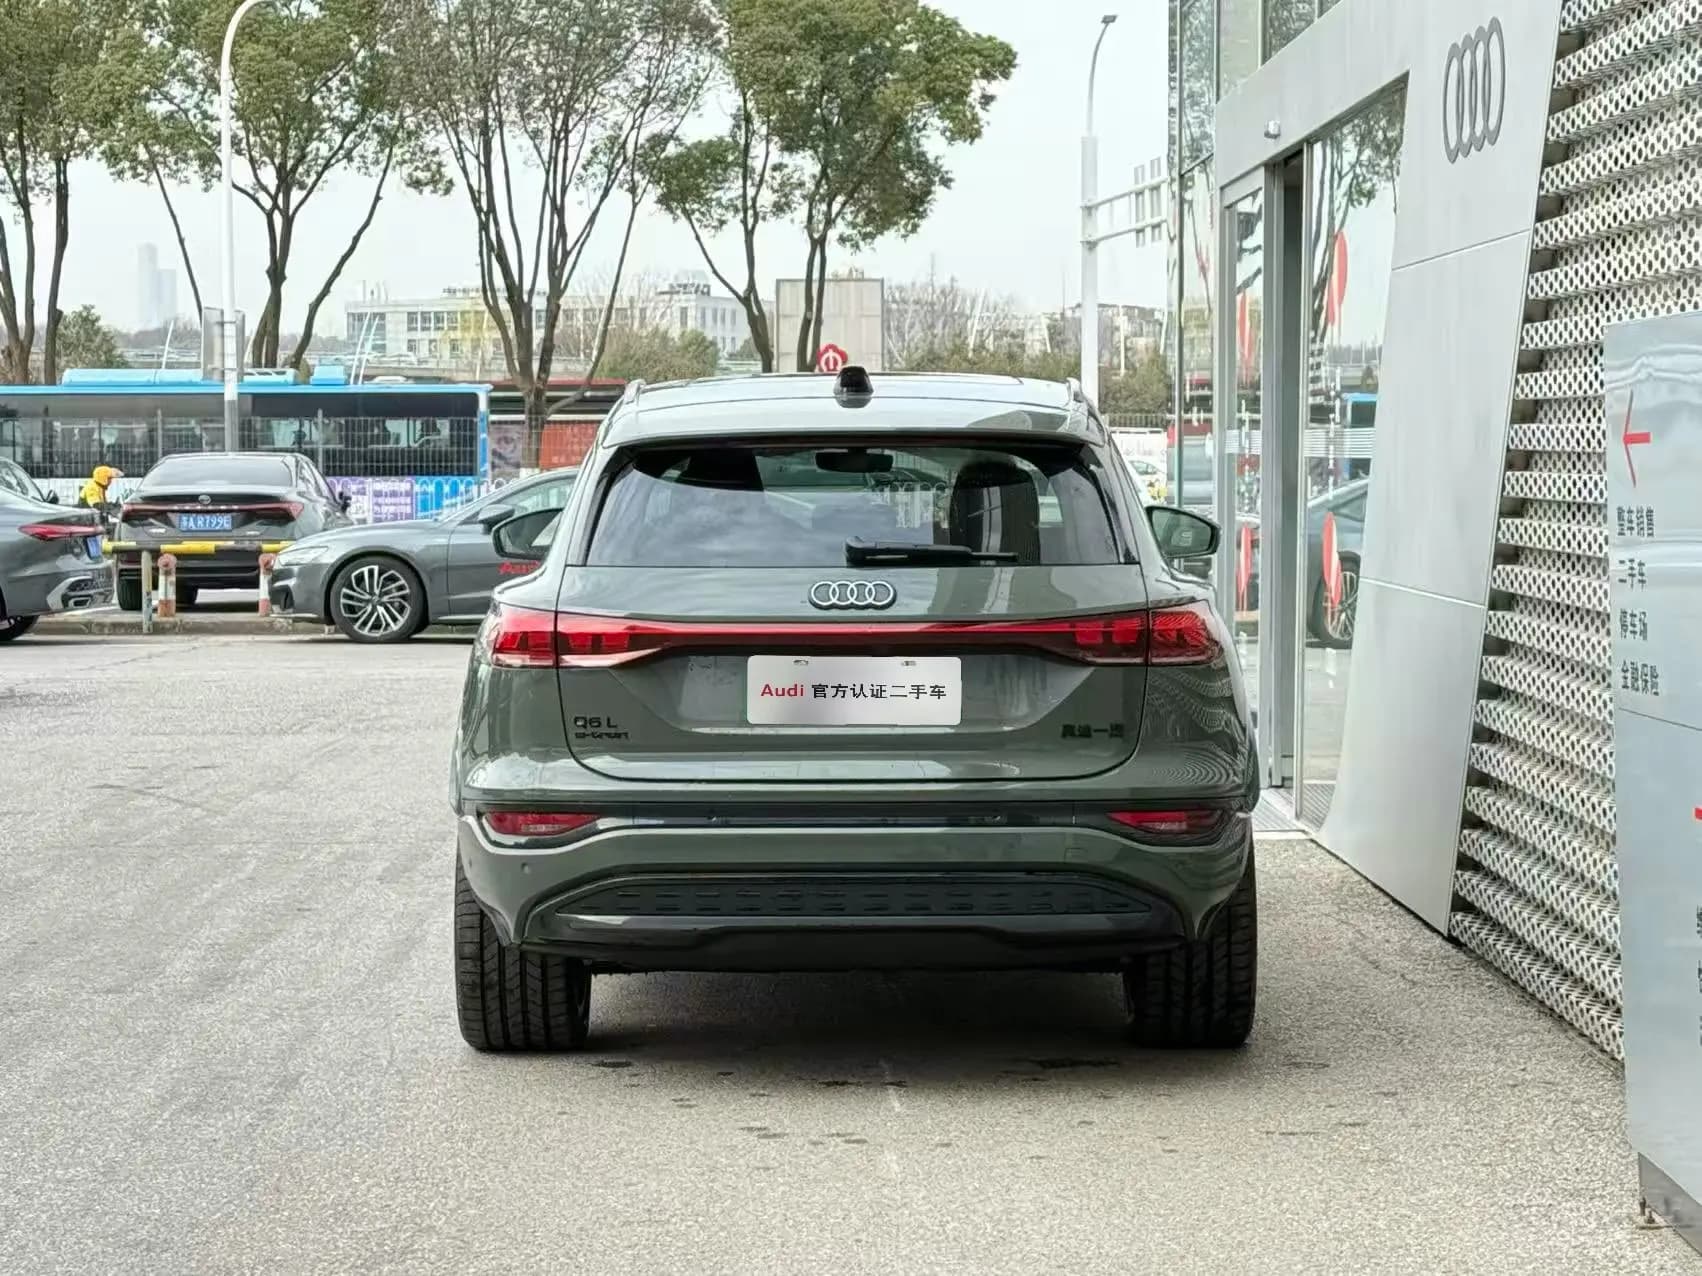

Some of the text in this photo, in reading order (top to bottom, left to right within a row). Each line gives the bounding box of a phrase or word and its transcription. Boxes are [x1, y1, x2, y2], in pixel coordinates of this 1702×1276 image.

[1618, 558, 1647, 591] 二手车
[1620, 608, 1648, 640] 停车场
[1621, 660, 1660, 697] 金融保险
[574, 716, 618, 729] Q6 L
